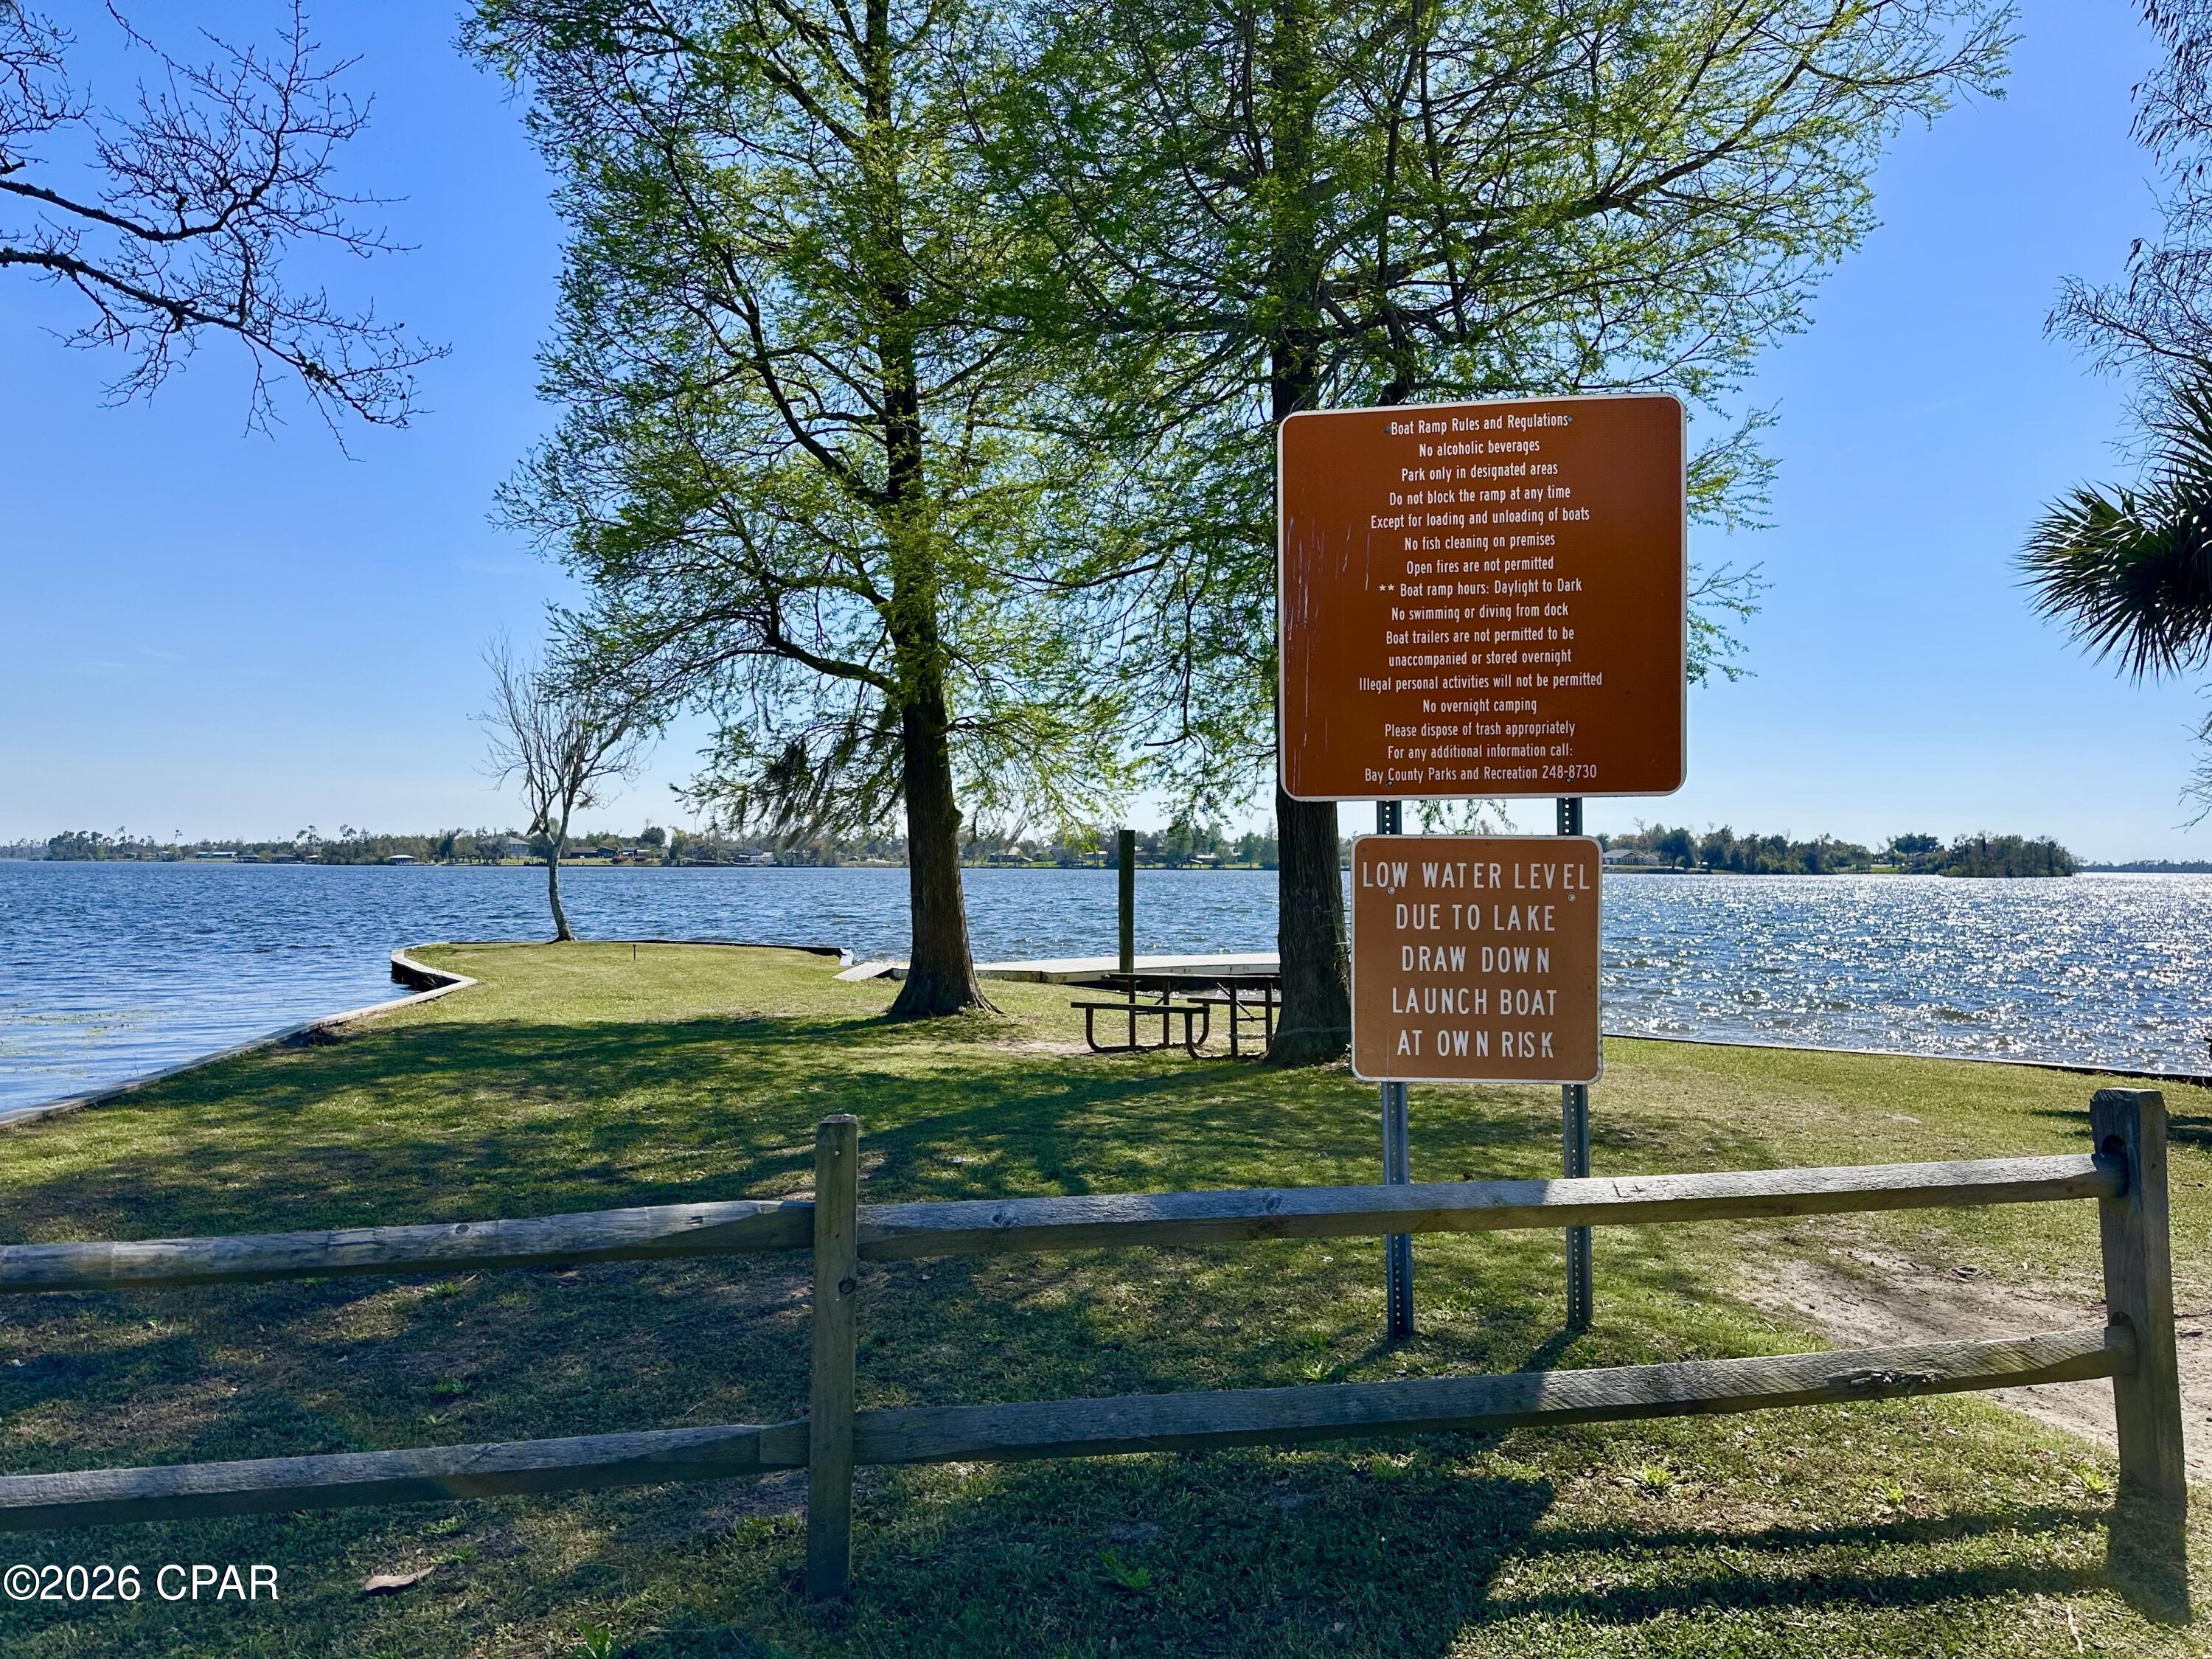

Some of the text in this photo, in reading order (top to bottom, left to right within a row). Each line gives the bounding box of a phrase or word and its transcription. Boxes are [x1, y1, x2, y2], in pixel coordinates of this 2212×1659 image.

[1390, 413, 1568, 436] Boat Ramp Rules and Regulations
[1419, 439, 1540, 457] No alcoholic beverages
[1402, 462, 1558, 483] Park only in designated areas
[1389, 484, 1571, 506] Do not block the ramp at any time
[1371, 507, 1590, 531] Except for loading and unloading of boats
[1405, 532, 1556, 552] No fish cleaning on premises
[1406, 556, 1554, 577] Open fires are not permitted
[1400, 582, 1423, 597] Boat
[1427, 585, 1453, 599] ramp
[1458, 581, 1489, 595] hours:
[1495, 579, 1539, 597] Daylight
[1542, 578, 1552, 592] to
[1557, 577, 1582, 592] Dark
[1391, 602, 1568, 623] No swimming or diving from dock
[1386, 626, 1574, 644] Boat trailers are not permitted to be
[1388, 648, 1572, 669] unaccompanied or stored overnight
[1359, 672, 1602, 695] Illegal personal activities will not be permitted
[1423, 696, 1537, 716] No overnight camping
[1385, 720, 1576, 739] Please dispose of trash appropriately
[1388, 742, 1573, 762] For any additional information call:
[1365, 764, 1597, 785] Bay County Parks and Recreation 248-8730
[1363, 861, 1590, 890] LOW WATER LEVEL
[1397, 903, 1555, 931] DUE TO LAKE
[1402, 945, 1549, 973] DRAW DOWN
[1392, 987, 1557, 1015] LAUNCH BOAT
[1397, 1029, 1554, 1058] AT OWN RISK
